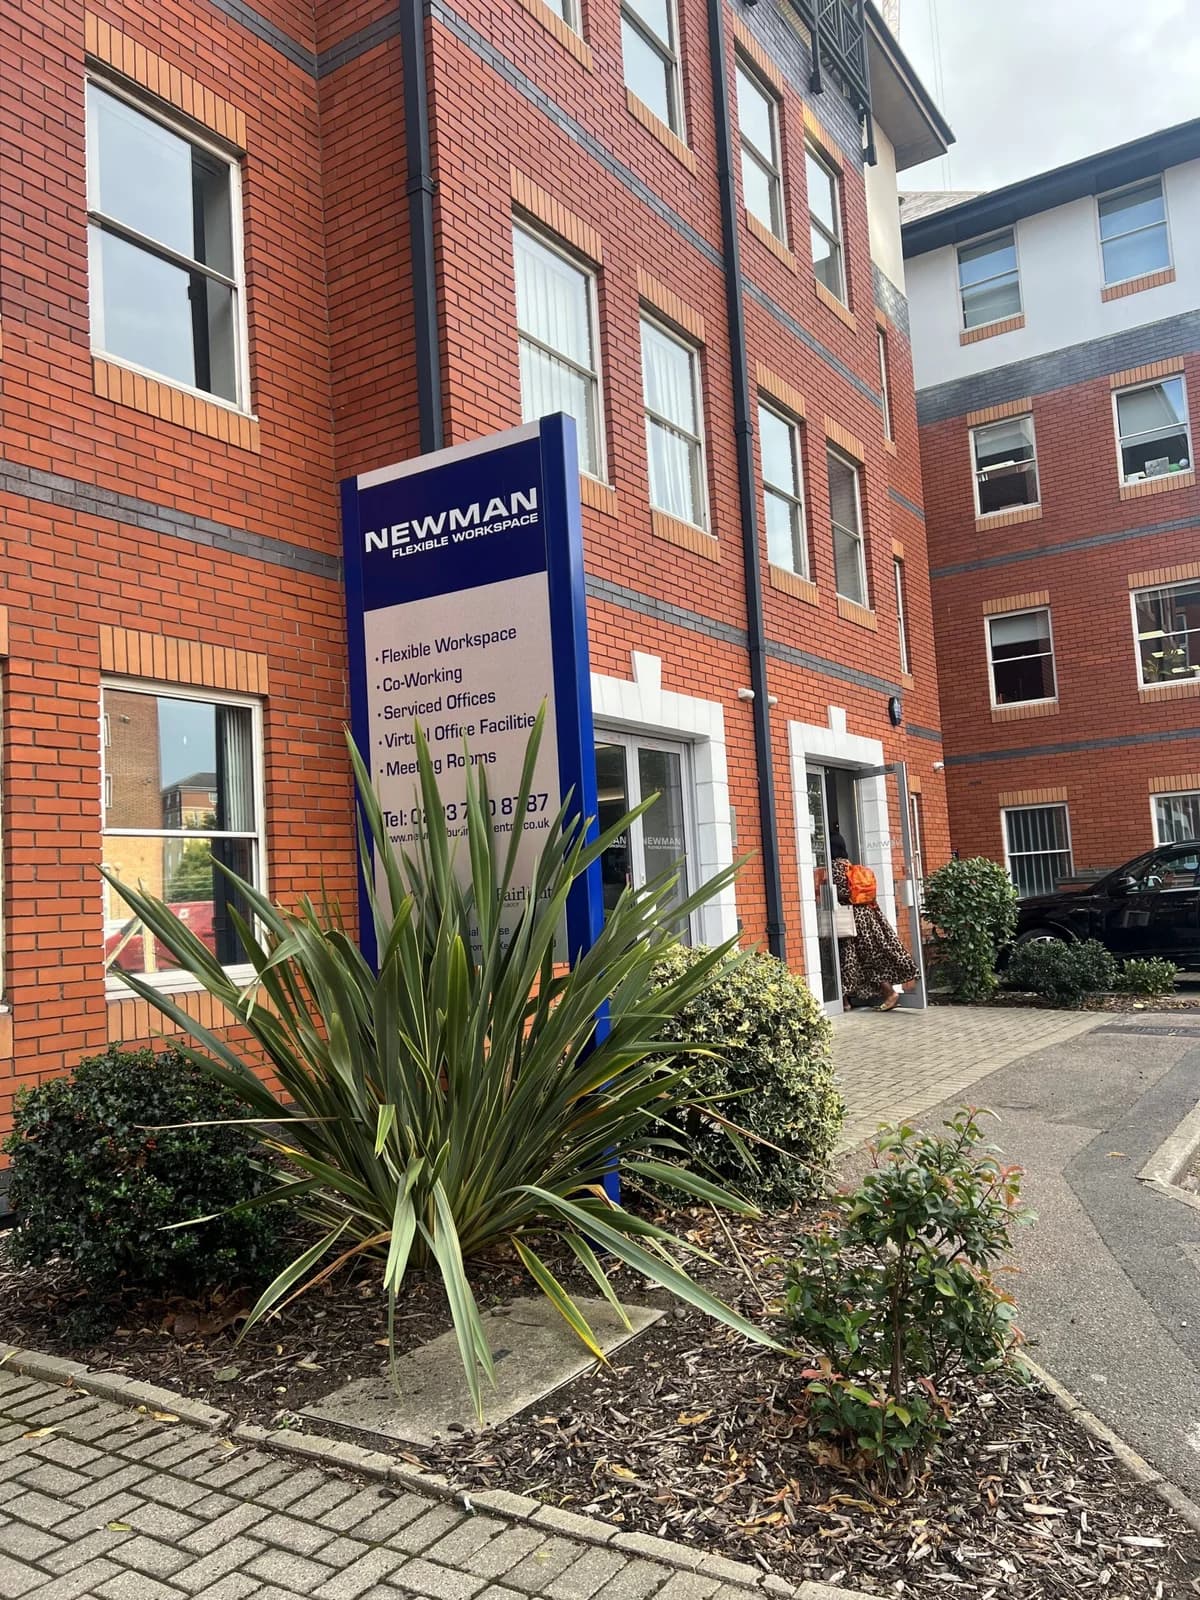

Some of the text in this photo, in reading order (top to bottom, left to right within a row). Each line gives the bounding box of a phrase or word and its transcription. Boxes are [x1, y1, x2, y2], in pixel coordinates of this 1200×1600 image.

[364, 487, 538, 553] NEWMAN
[392, 513, 539, 559] FLEXIBLE WORKSPACE
[381, 627, 517, 665] Flexible Workspace
[383, 667, 463, 693] Co-Working
[384, 690, 496, 720] Serviced Offices
[384, 712, 537, 748] Virtul Office Facilitie
[386, 759, 442, 777] Meetg
[383, 809, 407, 828] Tel:
[411, 804, 457, 825] 03
[460, 799, 496, 820] 70
